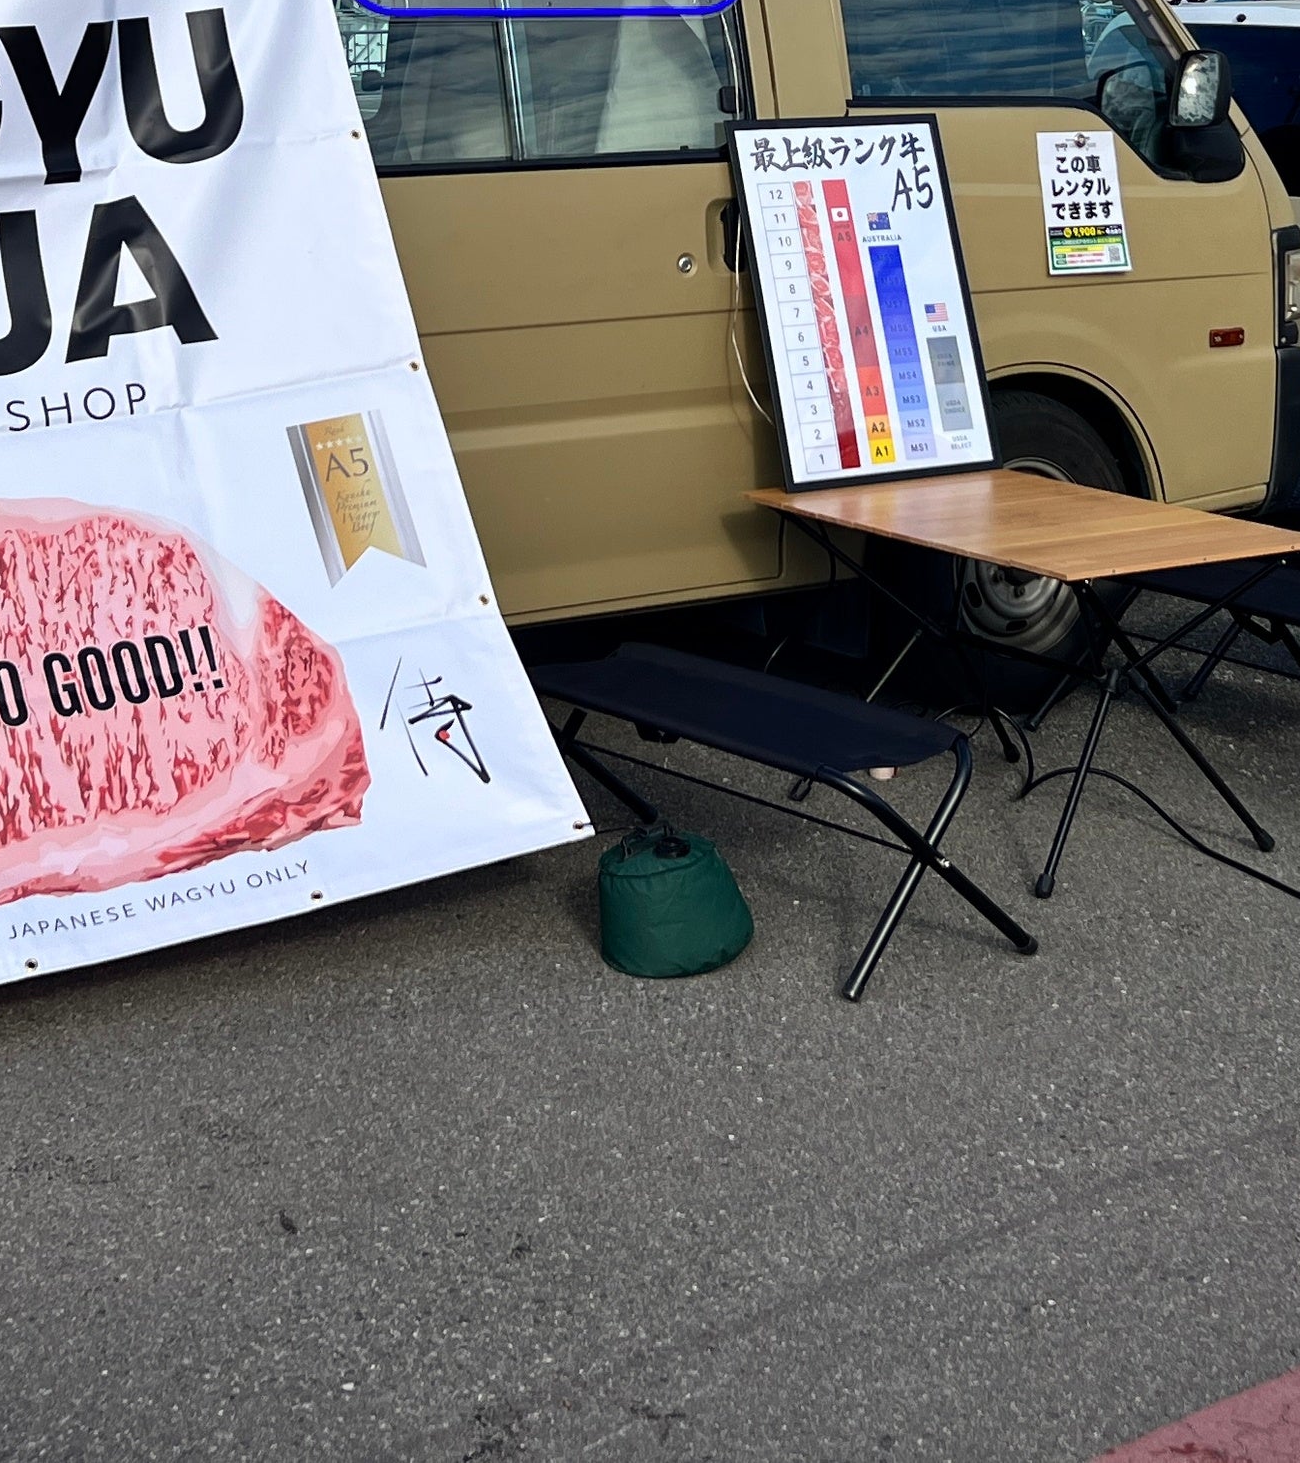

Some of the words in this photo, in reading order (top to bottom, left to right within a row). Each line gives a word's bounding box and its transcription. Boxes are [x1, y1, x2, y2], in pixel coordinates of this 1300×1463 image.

[749, 133, 925, 172] 最上級ランク牛
[1056, 155, 1102, 174] この車
[891, 164, 933, 212] A5
[1052, 178, 1111, 197] レンタル
[769, 189, 784, 200] 12
[1051, 201, 1113, 220] できます
[774, 213, 787, 224] 11
[778, 236, 792, 247] 10
[862, 234, 902, 243] AUSTRALIA
[785, 260, 792, 271] 9
[789, 284, 796, 295] 8
[794, 308, 800, 318] 7
[798, 332, 805, 343] 6
[802, 355, 810, 367] 5
[898, 370, 917, 380] MS4
[807, 380, 814, 391] 4
[865, 386, 880, 397] A3
[903, 394, 922, 404] MS3
[6, 382, 148, 432] SHOP
[811, 404, 818, 415] 3
[871, 422, 886, 433] A2
[907, 418, 926, 428] MS2
[814, 428, 821, 440] 2
[875, 447, 889, 458] A1
[910, 442, 930, 453] MS1
[325, 447, 369, 482] A5
[819, 454, 825, 465] 1
[42, 626, 225, 718] GOOD!!
[8, 901, 136, 940] JAPANESE
[145, 880, 237, 913] WAGYU
[247, 859, 311, 889] ONLY
